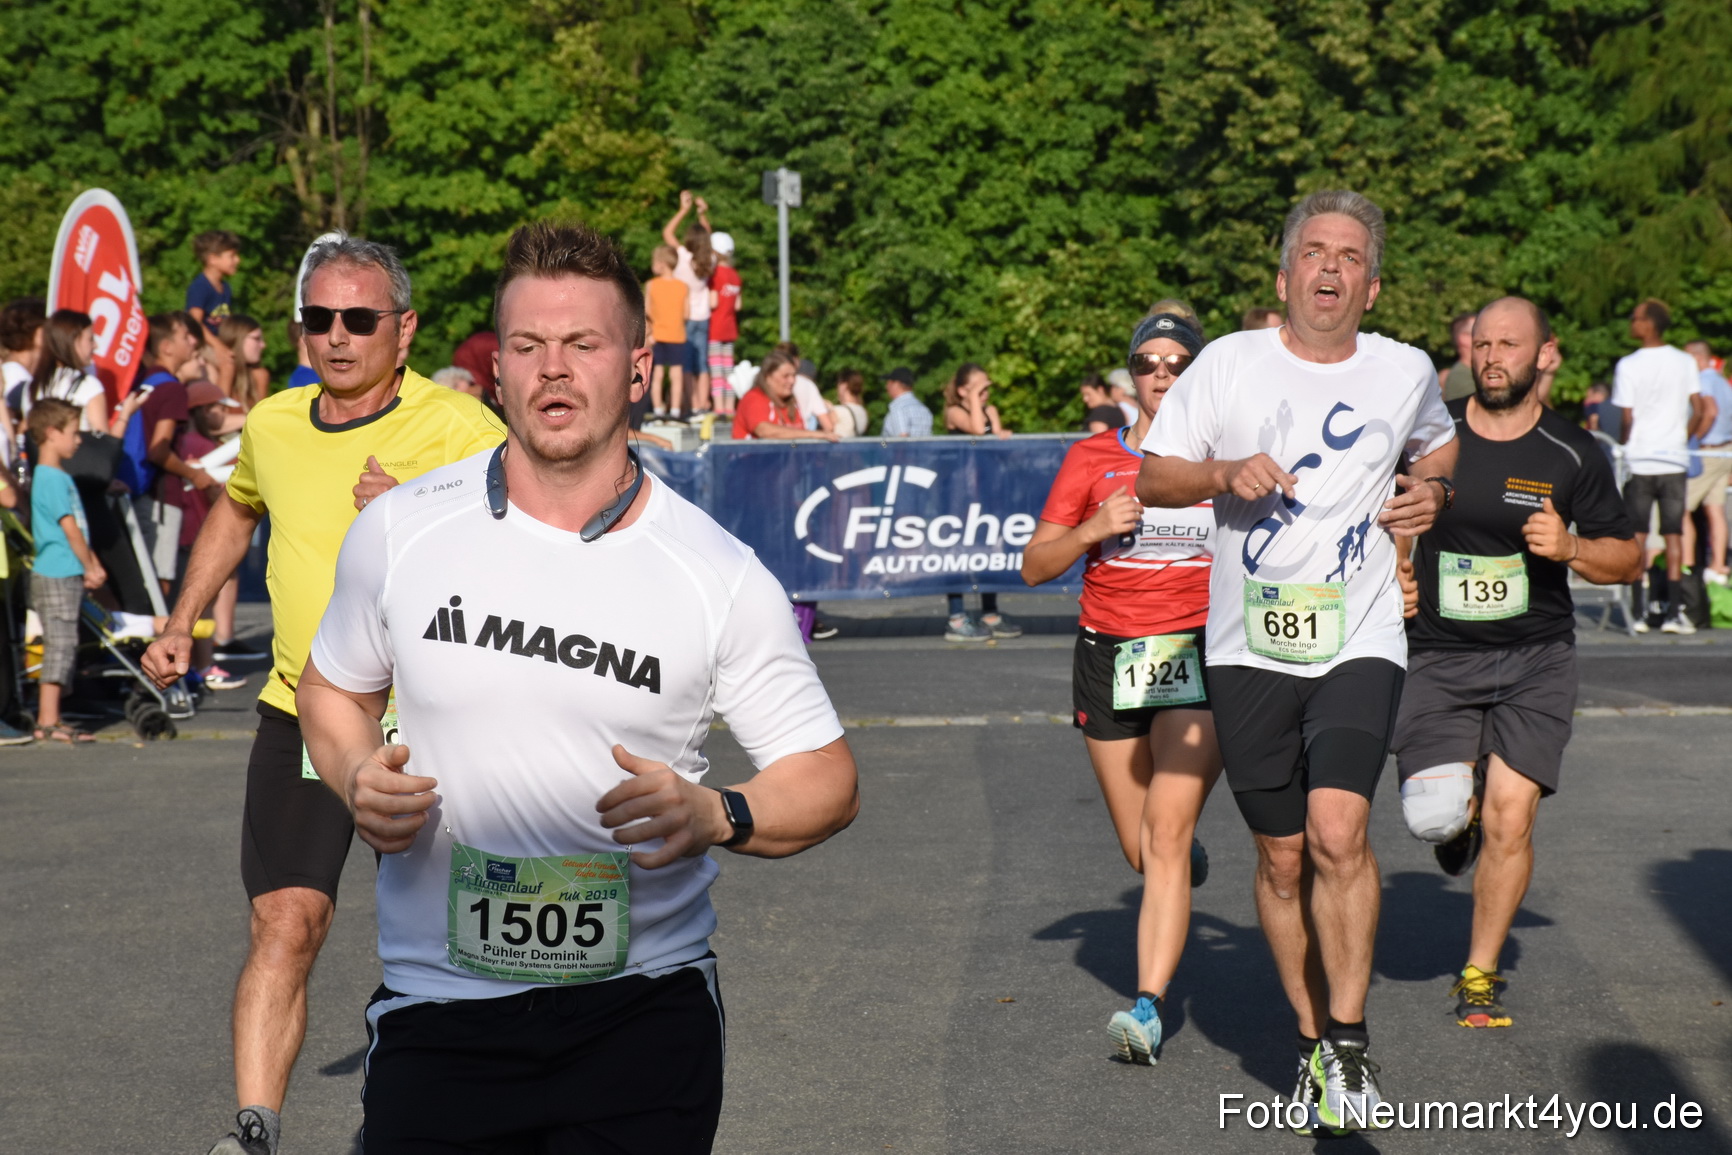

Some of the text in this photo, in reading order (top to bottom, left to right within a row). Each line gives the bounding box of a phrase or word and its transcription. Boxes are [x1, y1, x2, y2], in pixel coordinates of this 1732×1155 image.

[379, 460, 419, 469] PANGLER
[431, 479, 464, 493] JAKO
[843, 502, 1037, 549] Fische
[1140, 524, 1209, 541] Petry
[863, 552, 1024, 575] AUTOMOBIL
[1458, 579, 1508, 602] 139
[1320, 603, 1339, 611] 2019
[1263, 610, 1317, 639] 681
[474, 614, 661, 694] MAGNA
[1299, 640, 1318, 650] Ingo
[474, 875, 544, 894] firmenlauf
[585, 889, 617, 901] 2019
[470, 897, 605, 948] 1505
[457, 948, 616, 970] Magna Steyr Fuel Systems GmbH Neumarkt
[483, 943, 588, 961] Pühler Dominik
